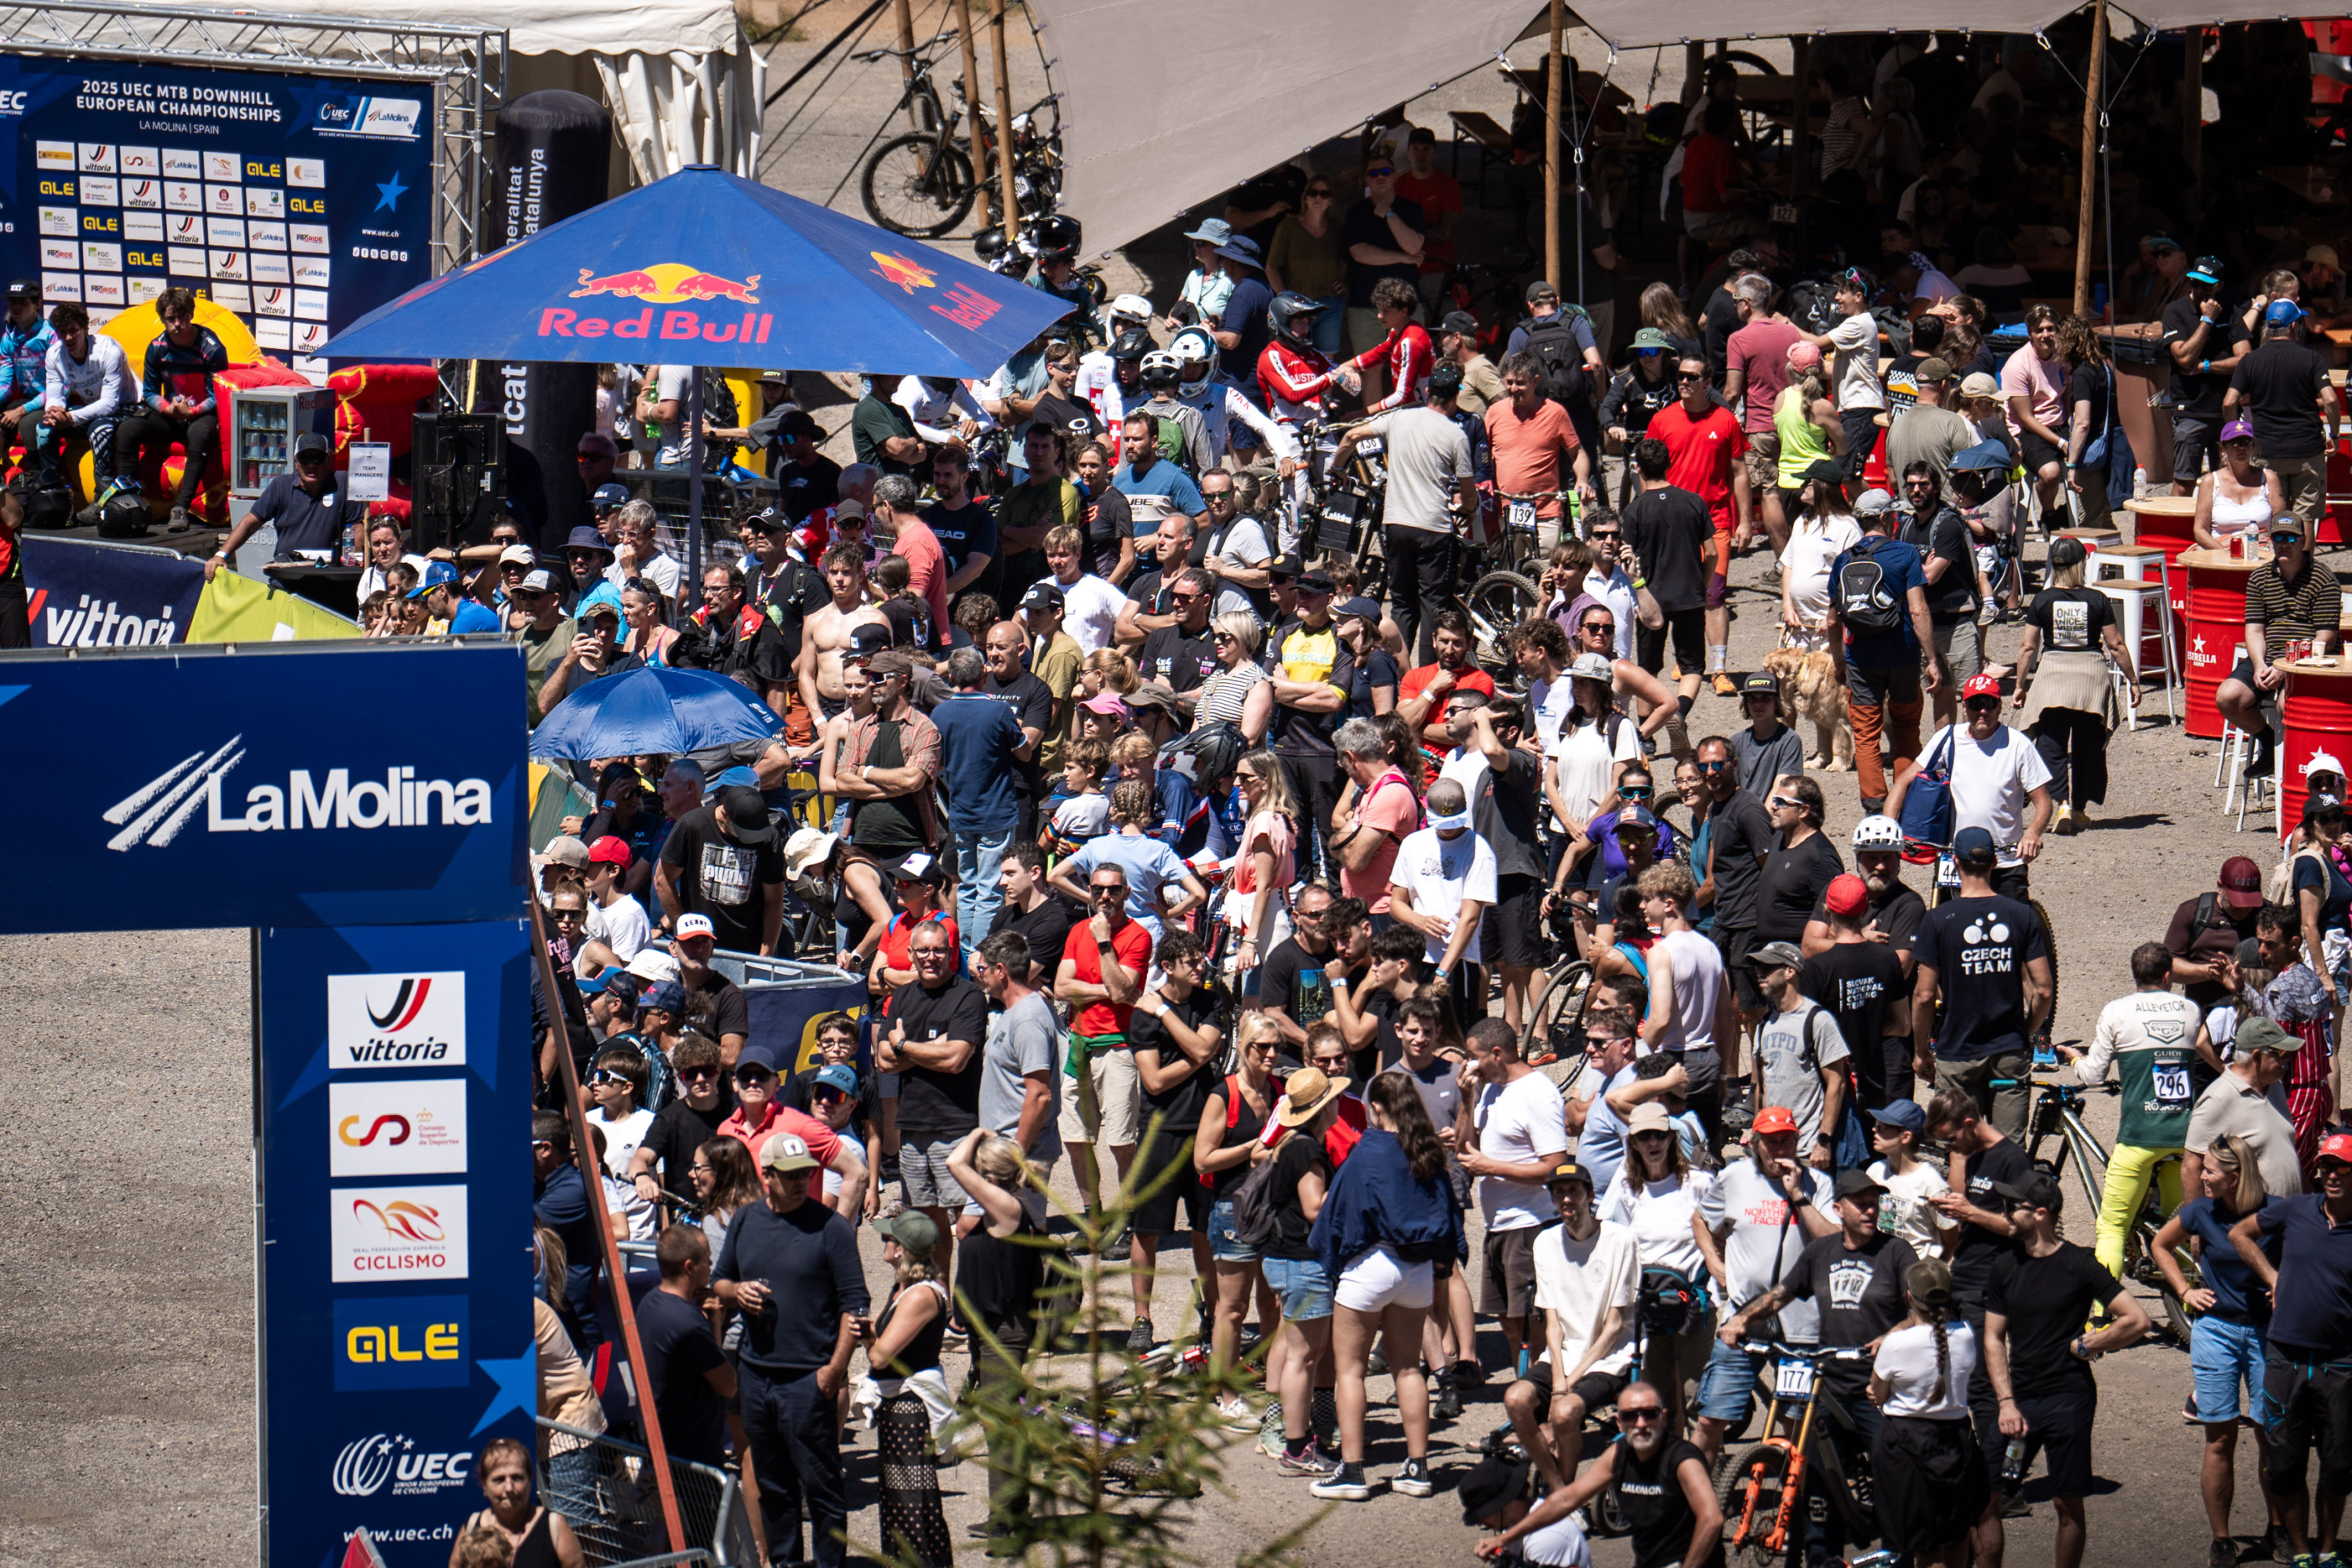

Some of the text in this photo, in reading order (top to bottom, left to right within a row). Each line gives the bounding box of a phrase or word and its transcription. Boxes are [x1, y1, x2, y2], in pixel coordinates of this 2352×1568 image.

[82, 80, 274, 106] 2025 UEC MTB DOWNHILL
[76, 96, 281, 122] EUROPEAN CHAMPIONSHIPS
[331, 109, 350, 118] UEC
[139, 120, 220, 135] LA MOLINA SPAIN
[84, 163, 111, 172] vittoria
[524, 147, 548, 240] atalunya
[129, 198, 156, 207] vittoria
[1777, 209, 1795, 221] 127
[172, 234, 199, 243] vittoria
[361, 228, 399, 238] www.uec.ch
[215, 270, 242, 279] vittoria
[260, 305, 285, 315] vittoria
[537, 307, 774, 345] Red Bull
[1512, 506, 1532, 524] 139
[934, 529, 966, 540] EAD
[2056, 607, 2081, 619] ONLY
[2058, 617, 2082, 626] NICE
[1301, 654, 1330, 664] CYCLES
[2187, 651, 2217, 664] ESTRELLA
[1969, 677, 1991, 687] FOX
[684, 919, 707, 927] KENNY
[1961, 947, 2013, 962] CZECH
[1961, 960, 2012, 975] TEAM
[1846, 983, 1884, 996] NATIONAL
[1846, 991, 1878, 1002] CYCLING
[2136, 1000, 2187, 1013] ALLEVETOR
[349, 1036, 448, 1062] vittoria
[829, 1069, 852, 1083] FOX
[2157, 1075, 2186, 1097] 296
[1761, 1200, 1781, 1208] THE
[1744, 1207, 1782, 1216] NORTH
[1753, 1216, 1781, 1225] FACE
[412, 1243, 446, 1252] ESPAÑOLA
[354, 1253, 446, 1271] CICLISMO
[1784, 1370, 1805, 1389] 177
[395, 1451, 473, 1481] UEC
[419, 1479, 466, 1488] EUROPÉENNE
[1621, 1482, 1663, 1496] SALOMON
[343, 1523, 453, 1543] ww.uec.ch
